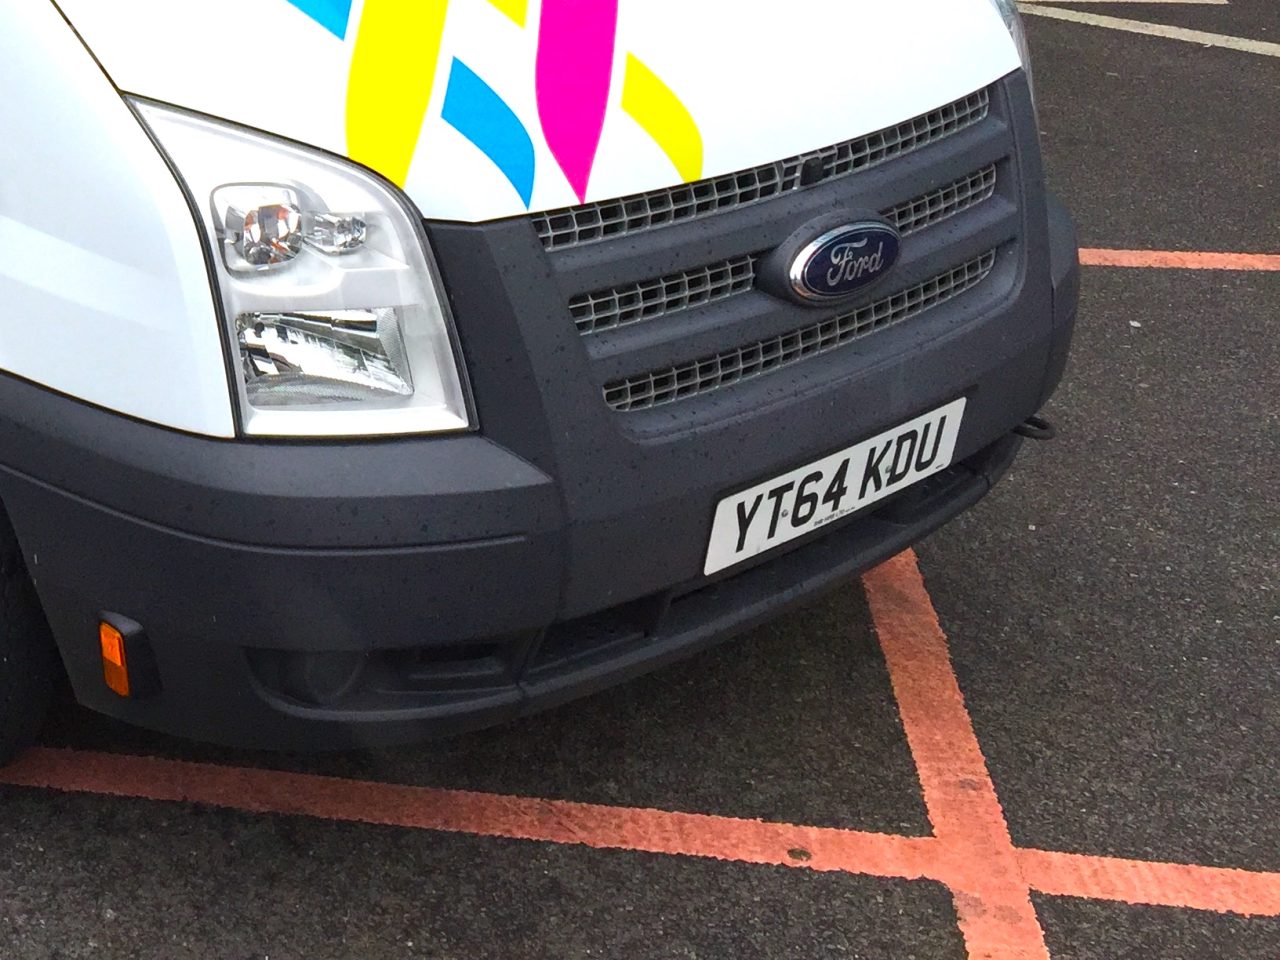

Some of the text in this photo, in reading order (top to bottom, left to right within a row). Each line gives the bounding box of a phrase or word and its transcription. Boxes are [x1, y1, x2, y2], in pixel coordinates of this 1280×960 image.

[826, 237, 884, 287] Ford
[735, 415, 948, 554] YT64 KDU
